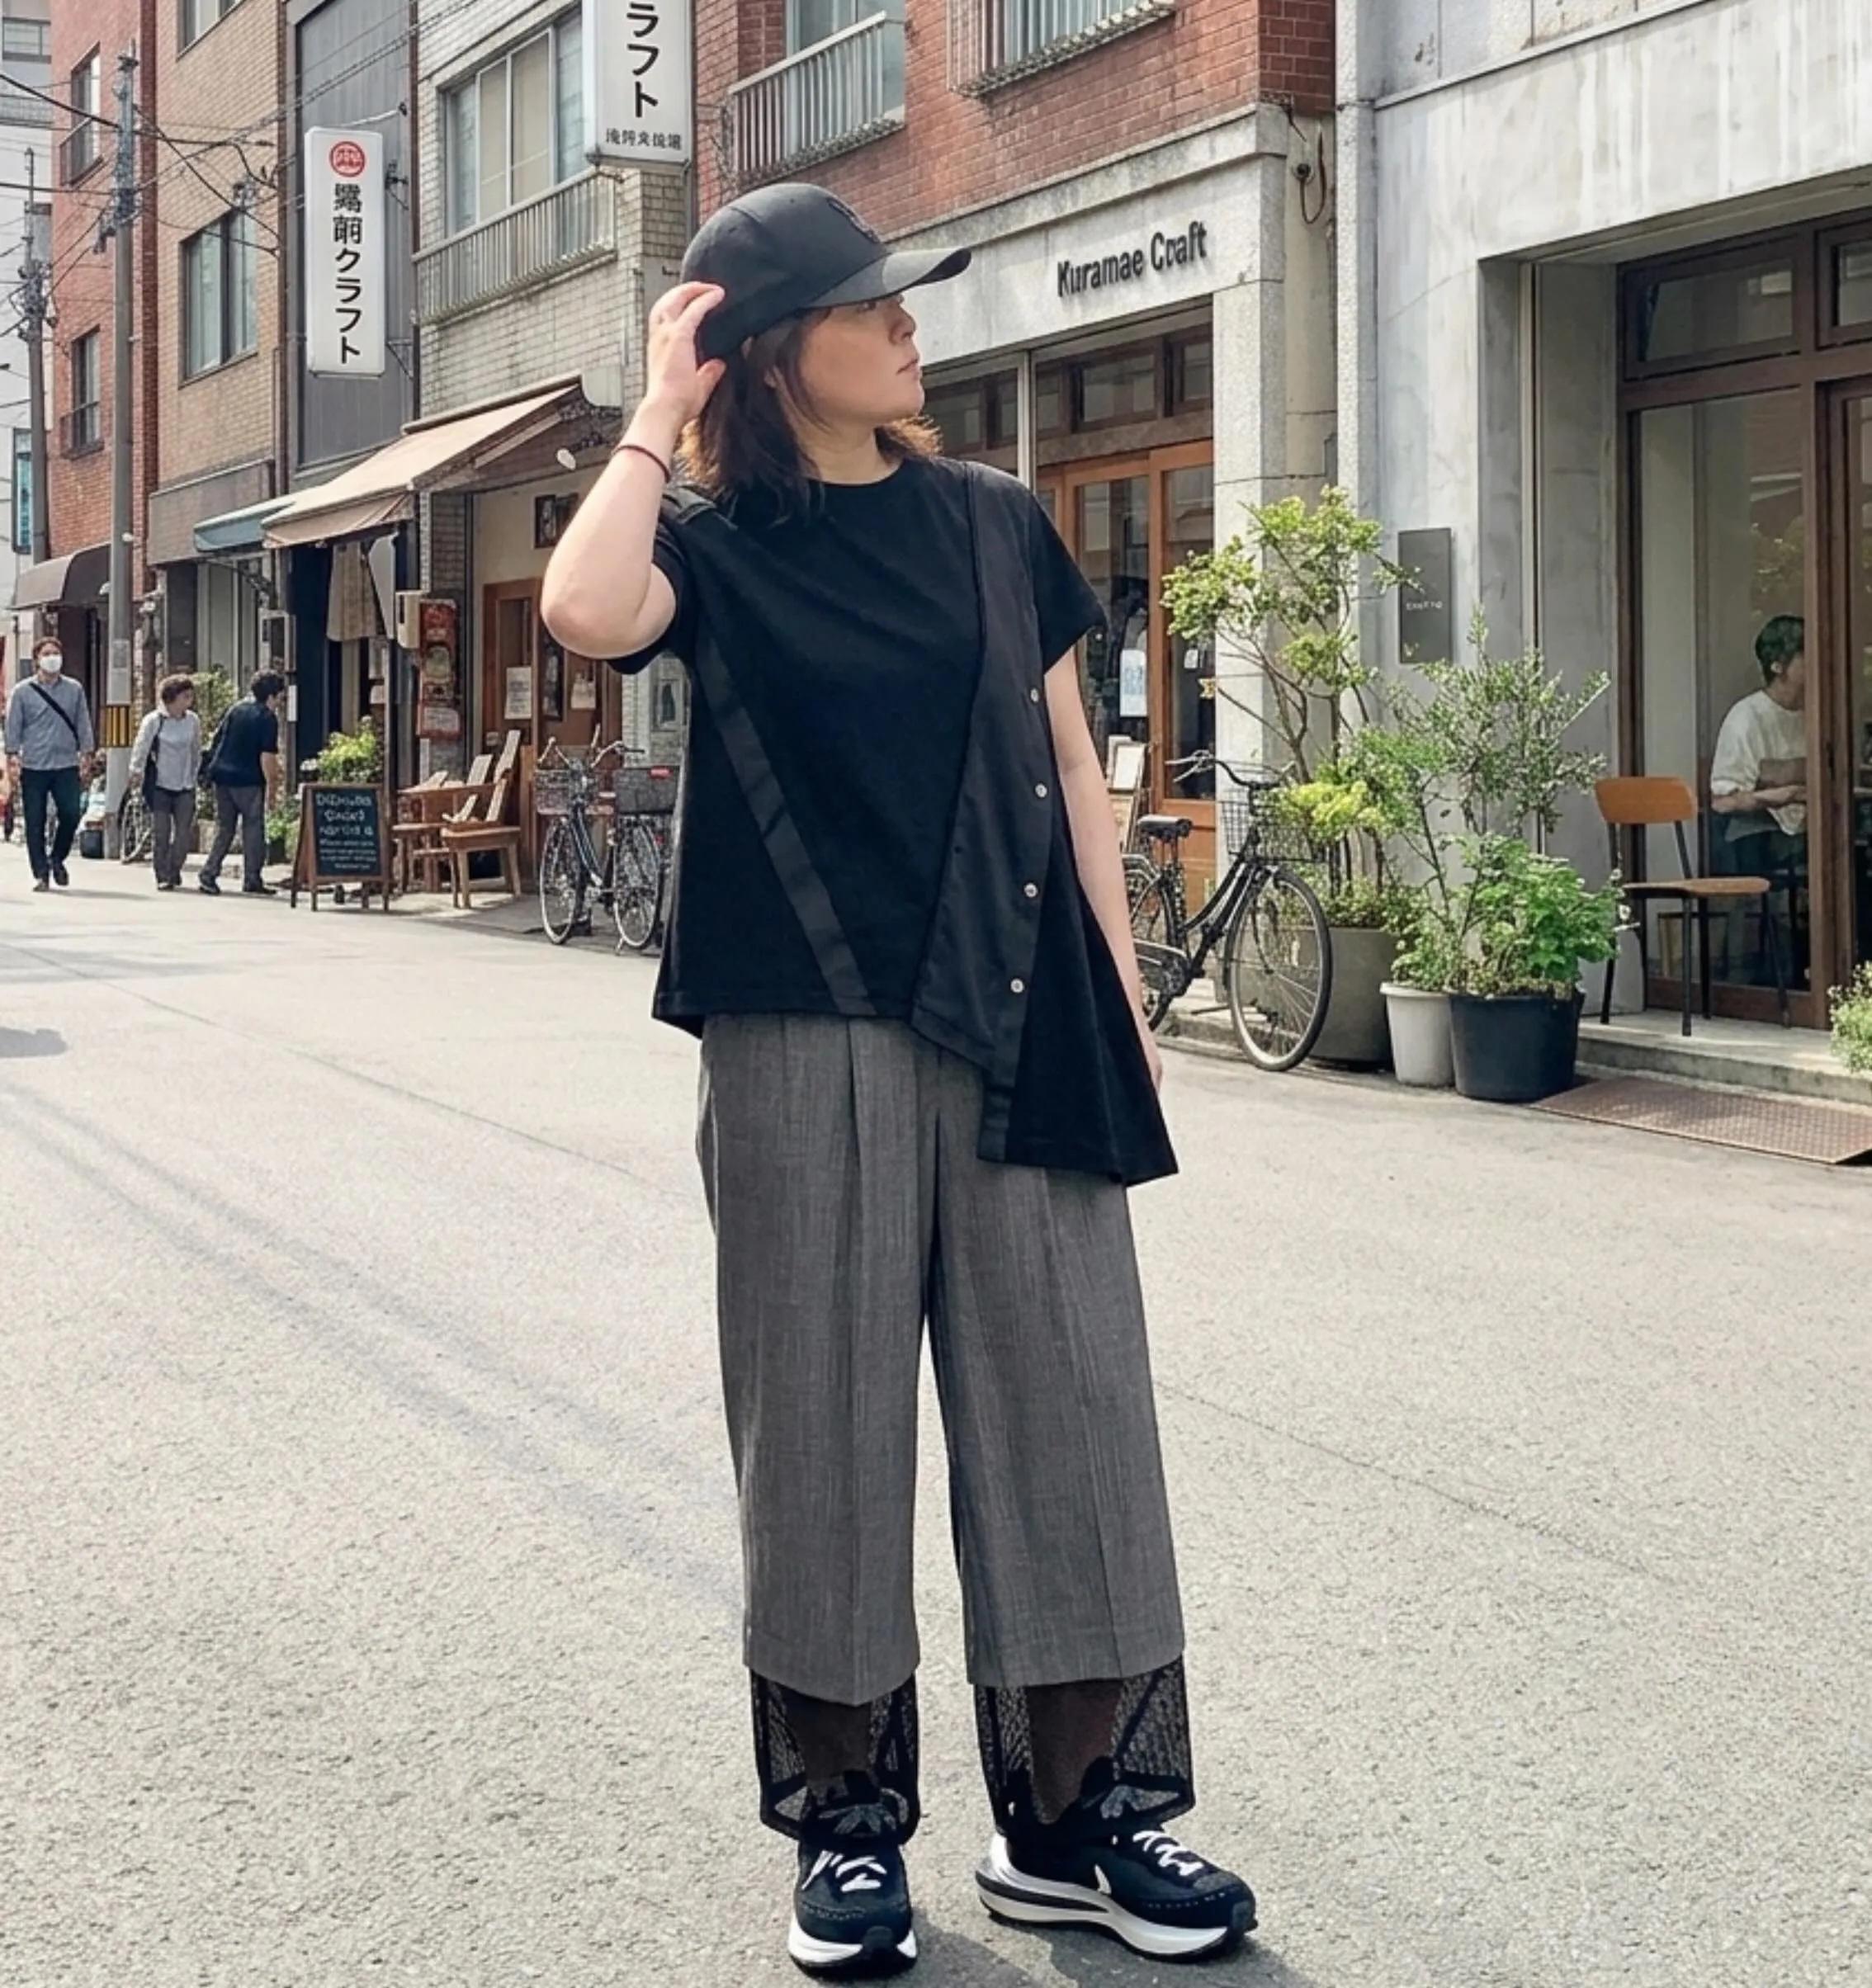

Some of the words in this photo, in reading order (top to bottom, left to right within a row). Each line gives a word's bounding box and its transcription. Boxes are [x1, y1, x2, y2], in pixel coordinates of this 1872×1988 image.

[626, 2, 659, 118] ラフト
[1057, 248, 1144, 297] Kuramae
